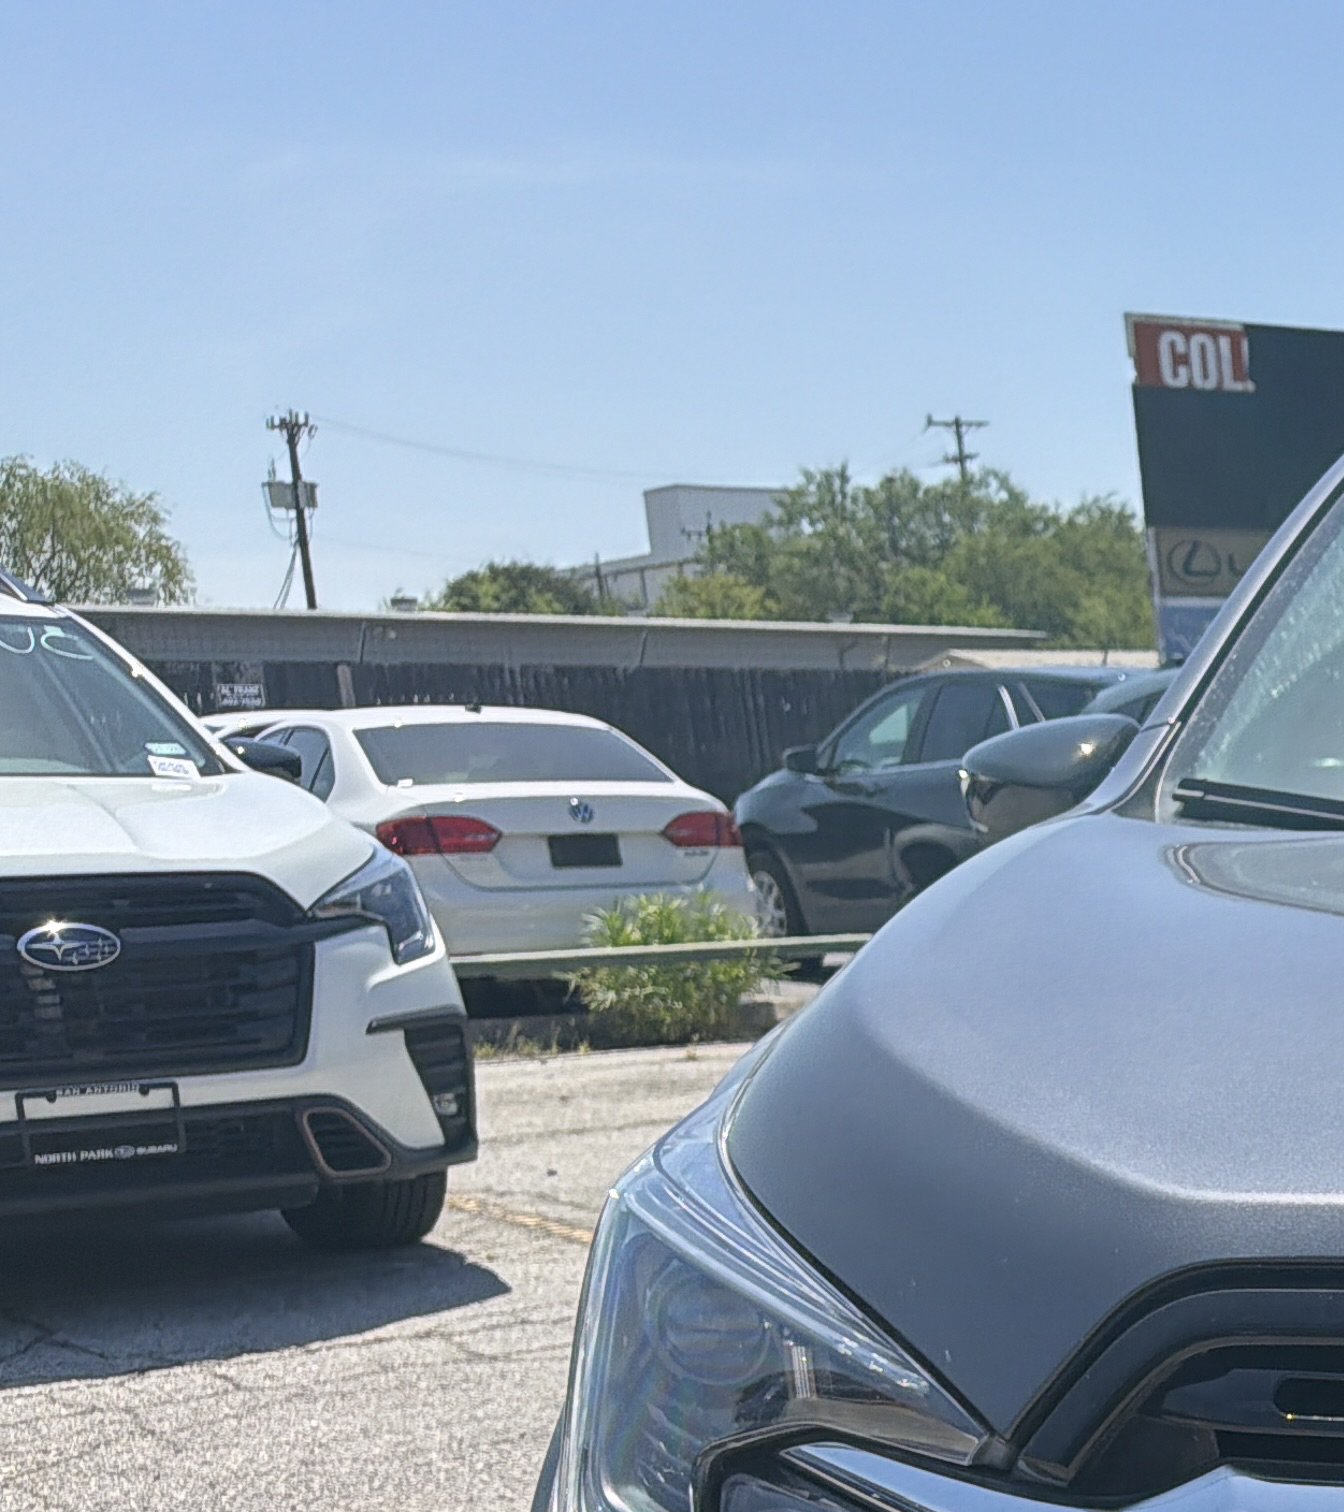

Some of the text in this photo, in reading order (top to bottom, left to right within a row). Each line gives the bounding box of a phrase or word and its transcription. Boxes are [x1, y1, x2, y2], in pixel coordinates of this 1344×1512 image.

[34, 1144, 178, 1165] NORTH PARK SUBARU
